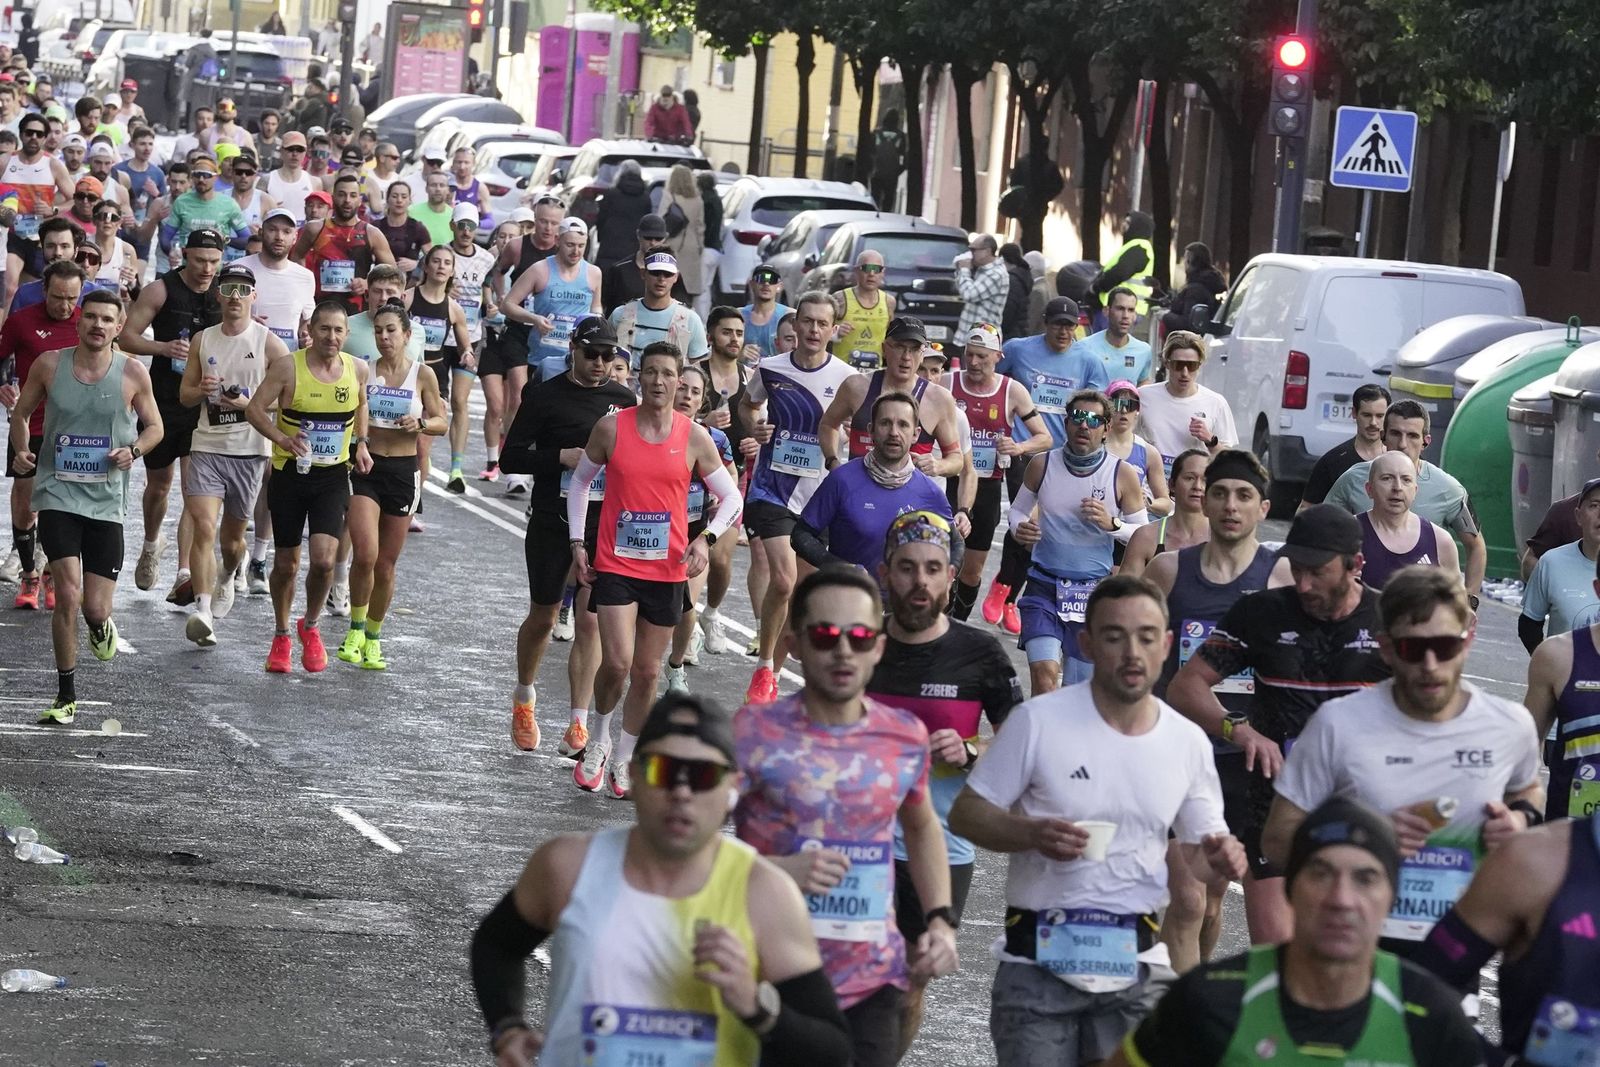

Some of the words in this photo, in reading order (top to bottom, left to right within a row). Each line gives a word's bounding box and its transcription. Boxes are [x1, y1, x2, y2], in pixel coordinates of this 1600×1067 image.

[550, 289, 587, 300] Lothian
[422, 319, 443, 327] ZURICH
[1047, 377, 1070, 387] ZURICH
[380, 388, 408, 397] ZURICH
[1039, 394, 1063, 405] MEHDI
[219, 413, 237, 423] DAN
[317, 423, 342, 431] ZURICH
[72, 438, 103, 446] ZURICH
[793, 433, 820, 443] ZURICH
[73, 451, 90, 459] 9376
[791, 446, 806, 455] 5643
[783, 453, 810, 466] PIOTR
[63, 460, 99, 472] MAXOU
[635, 513, 666, 521] ZURICH
[635, 527, 652, 535] 6784
[627, 535, 659, 548] PABLO
[920, 683, 958, 698] 226ERS
[1455, 749, 1493, 764] TCE
[1404, 879, 1434, 892] 7222
[808, 893, 871, 916] SIMON
[1072, 935, 1102, 948] 9493
[1080, 959, 1136, 975] SERRANO
